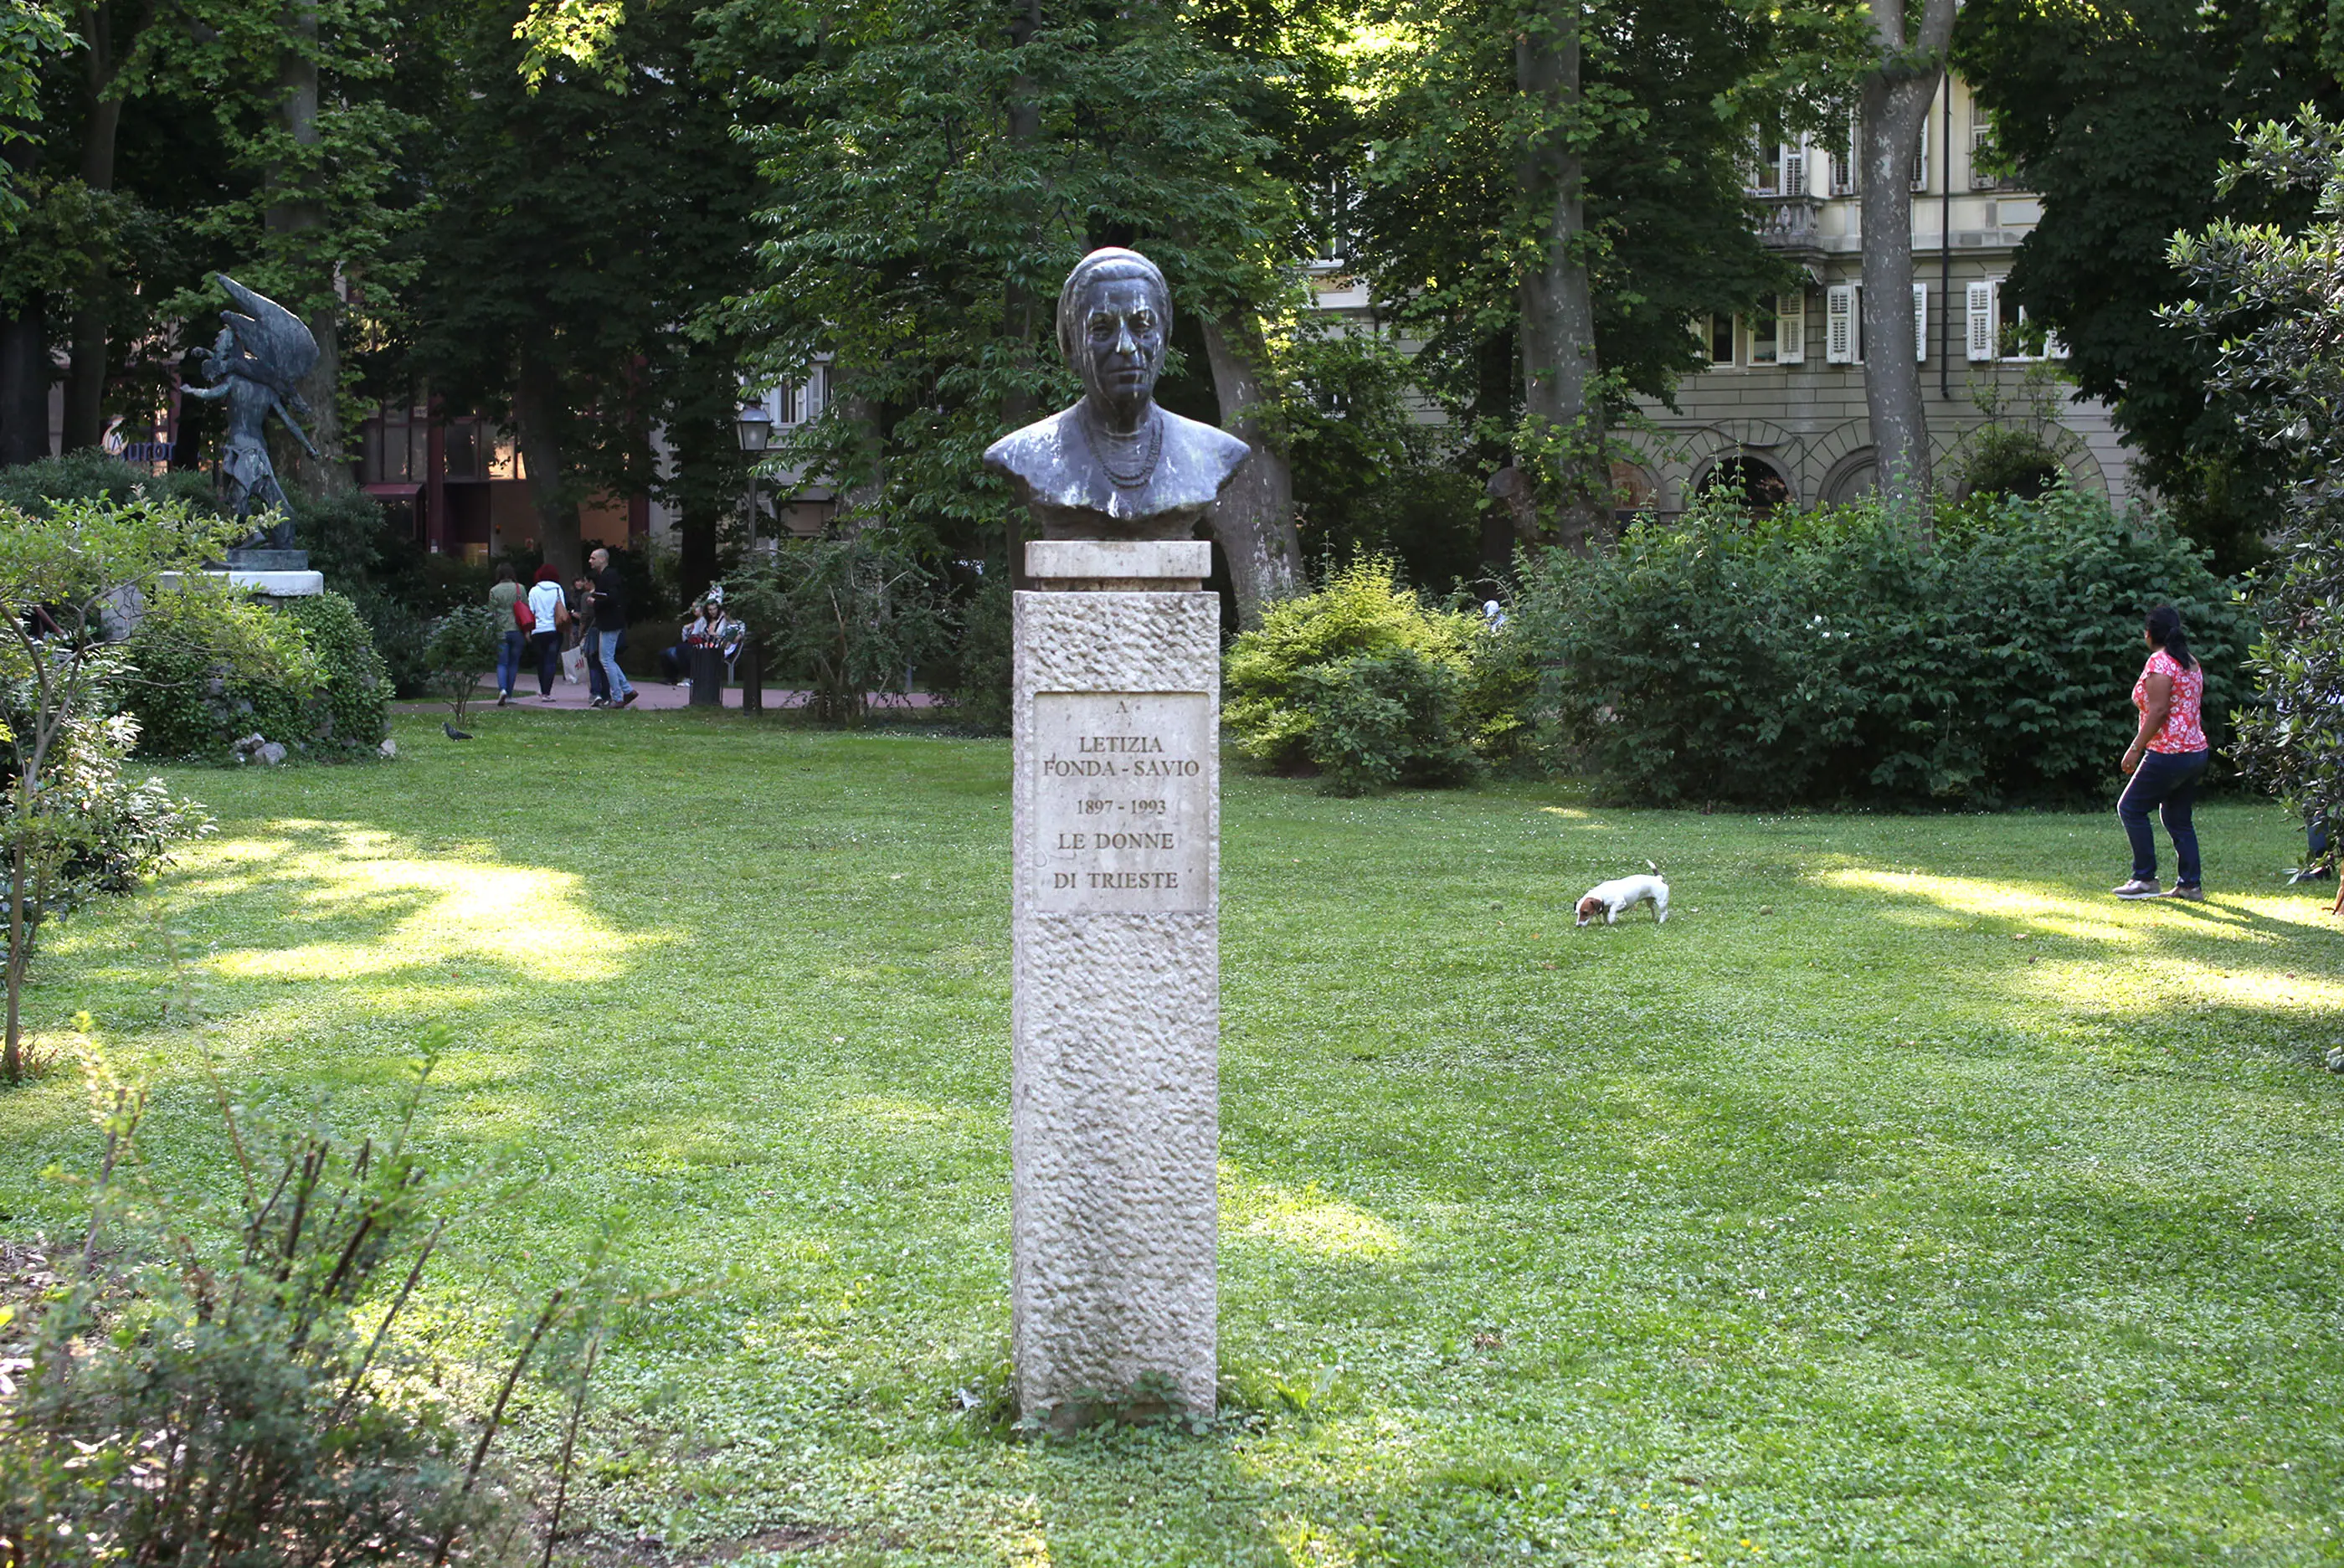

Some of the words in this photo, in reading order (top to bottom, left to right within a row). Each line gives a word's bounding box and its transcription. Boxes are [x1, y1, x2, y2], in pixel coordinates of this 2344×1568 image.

[108, 433, 177, 461] Auror
[1115, 701, 1128, 713] A
[1079, 737, 1164, 753] LETIZIA
[1057, 834, 1085, 850] LE
[1095, 834, 1174, 850] DONNE
[1054, 873, 1076, 889] DI
[1088, 873, 1178, 889] TRIESTE
